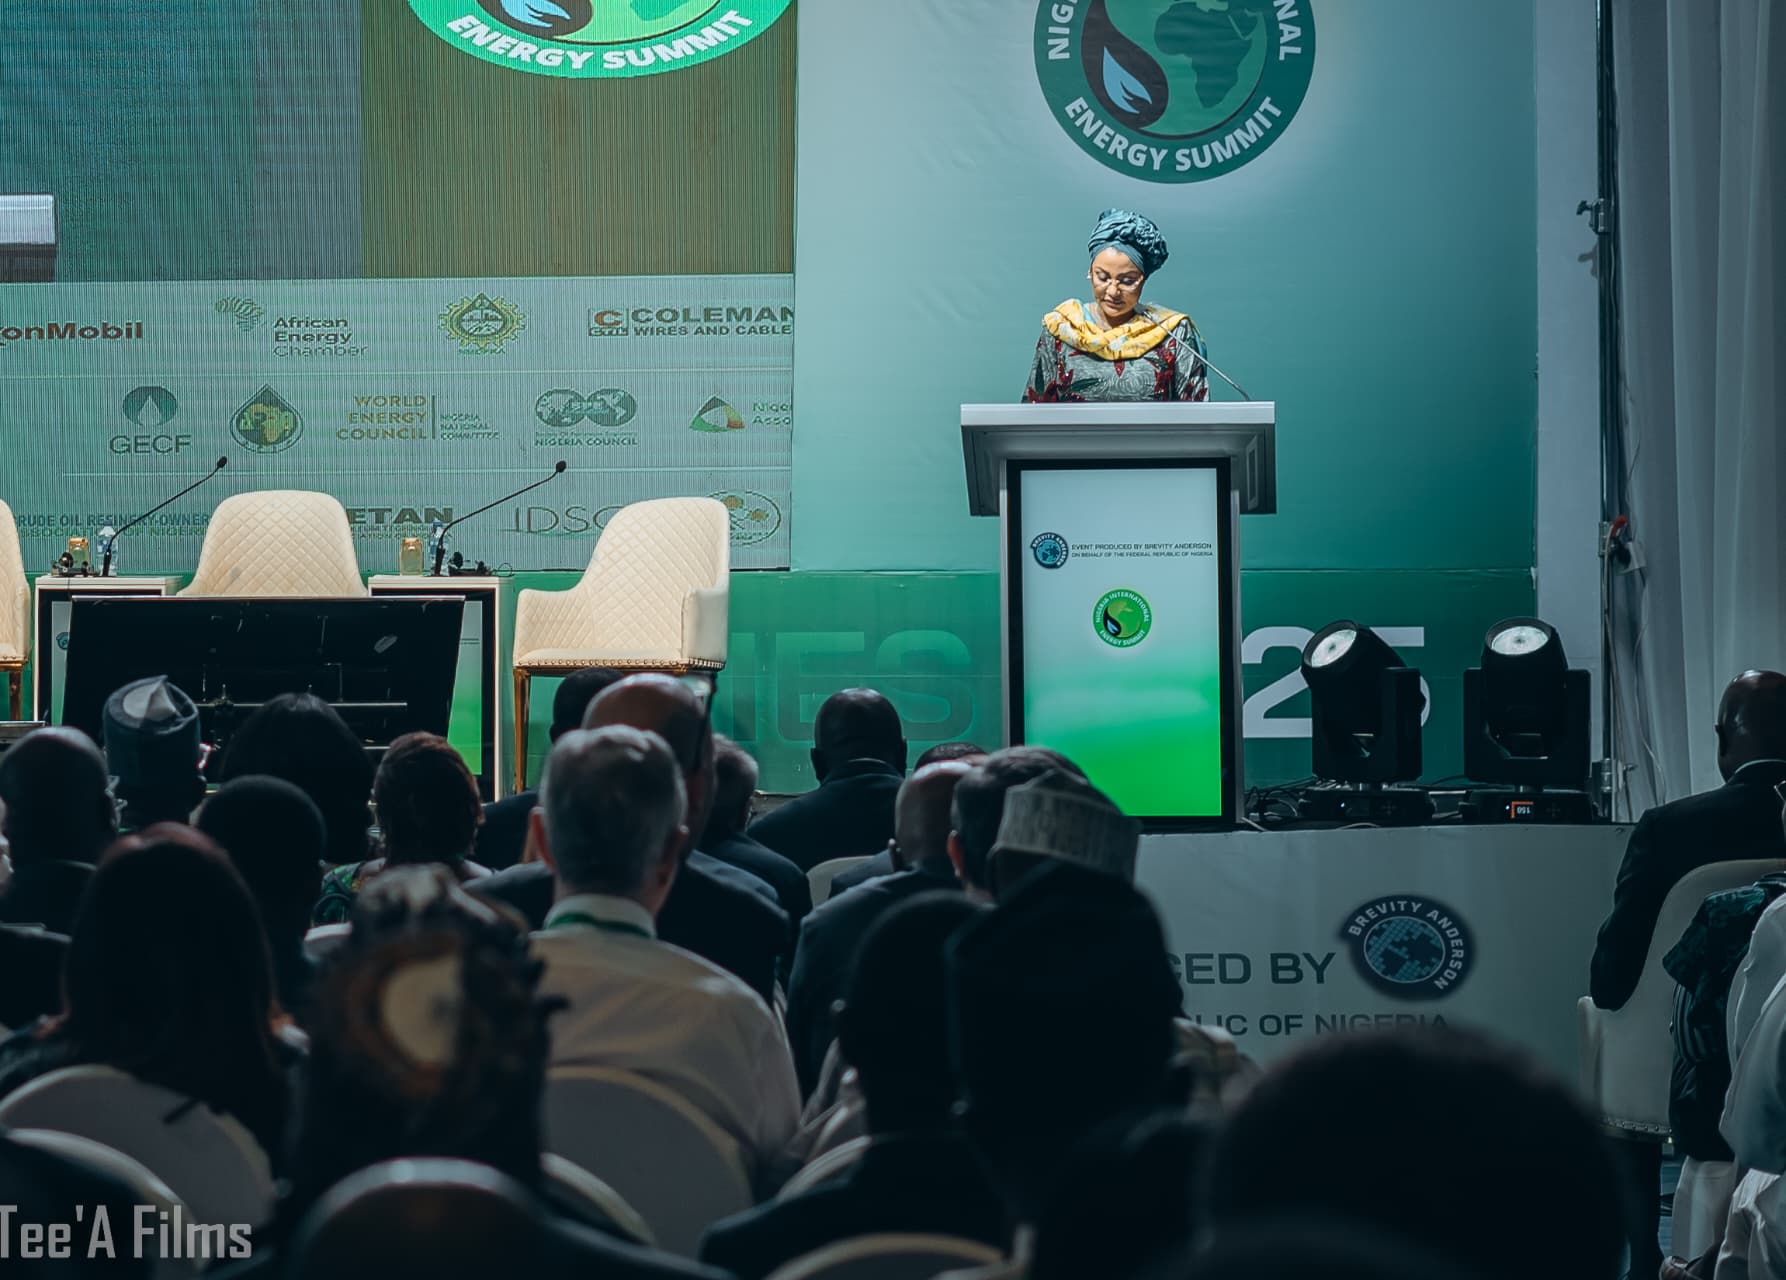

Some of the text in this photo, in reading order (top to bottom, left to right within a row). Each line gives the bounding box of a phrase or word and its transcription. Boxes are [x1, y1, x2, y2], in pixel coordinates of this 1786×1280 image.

[447, 9, 753, 69] ENERGY SUMMIT
[1064, 96, 1282, 171] ENERGY SUMMIT
[274, 317, 348, 328] African
[0, 322, 143, 343] onMobil
[634, 326, 688, 336] WIRES
[694, 325, 730, 336] AND
[275, 331, 352, 344] Energy
[273, 345, 369, 358] Chamber
[354, 395, 427, 407] WORLD
[348, 412, 427, 424] ENERGY
[336, 428, 427, 441] COUNCIL
[109, 435, 191, 454] GECF
[534, 438, 638, 446] NIGERIA COUNCIL
[16, 514, 56, 527] RUDE
[59, 514, 83, 526] OIL
[1072, 543, 1093, 551] EVENT
[1349, 901, 1465, 989] BREVITY ANDERSON
[1270, 952, 1336, 985] BY
[1259, 1014, 1303, 1036] OF
